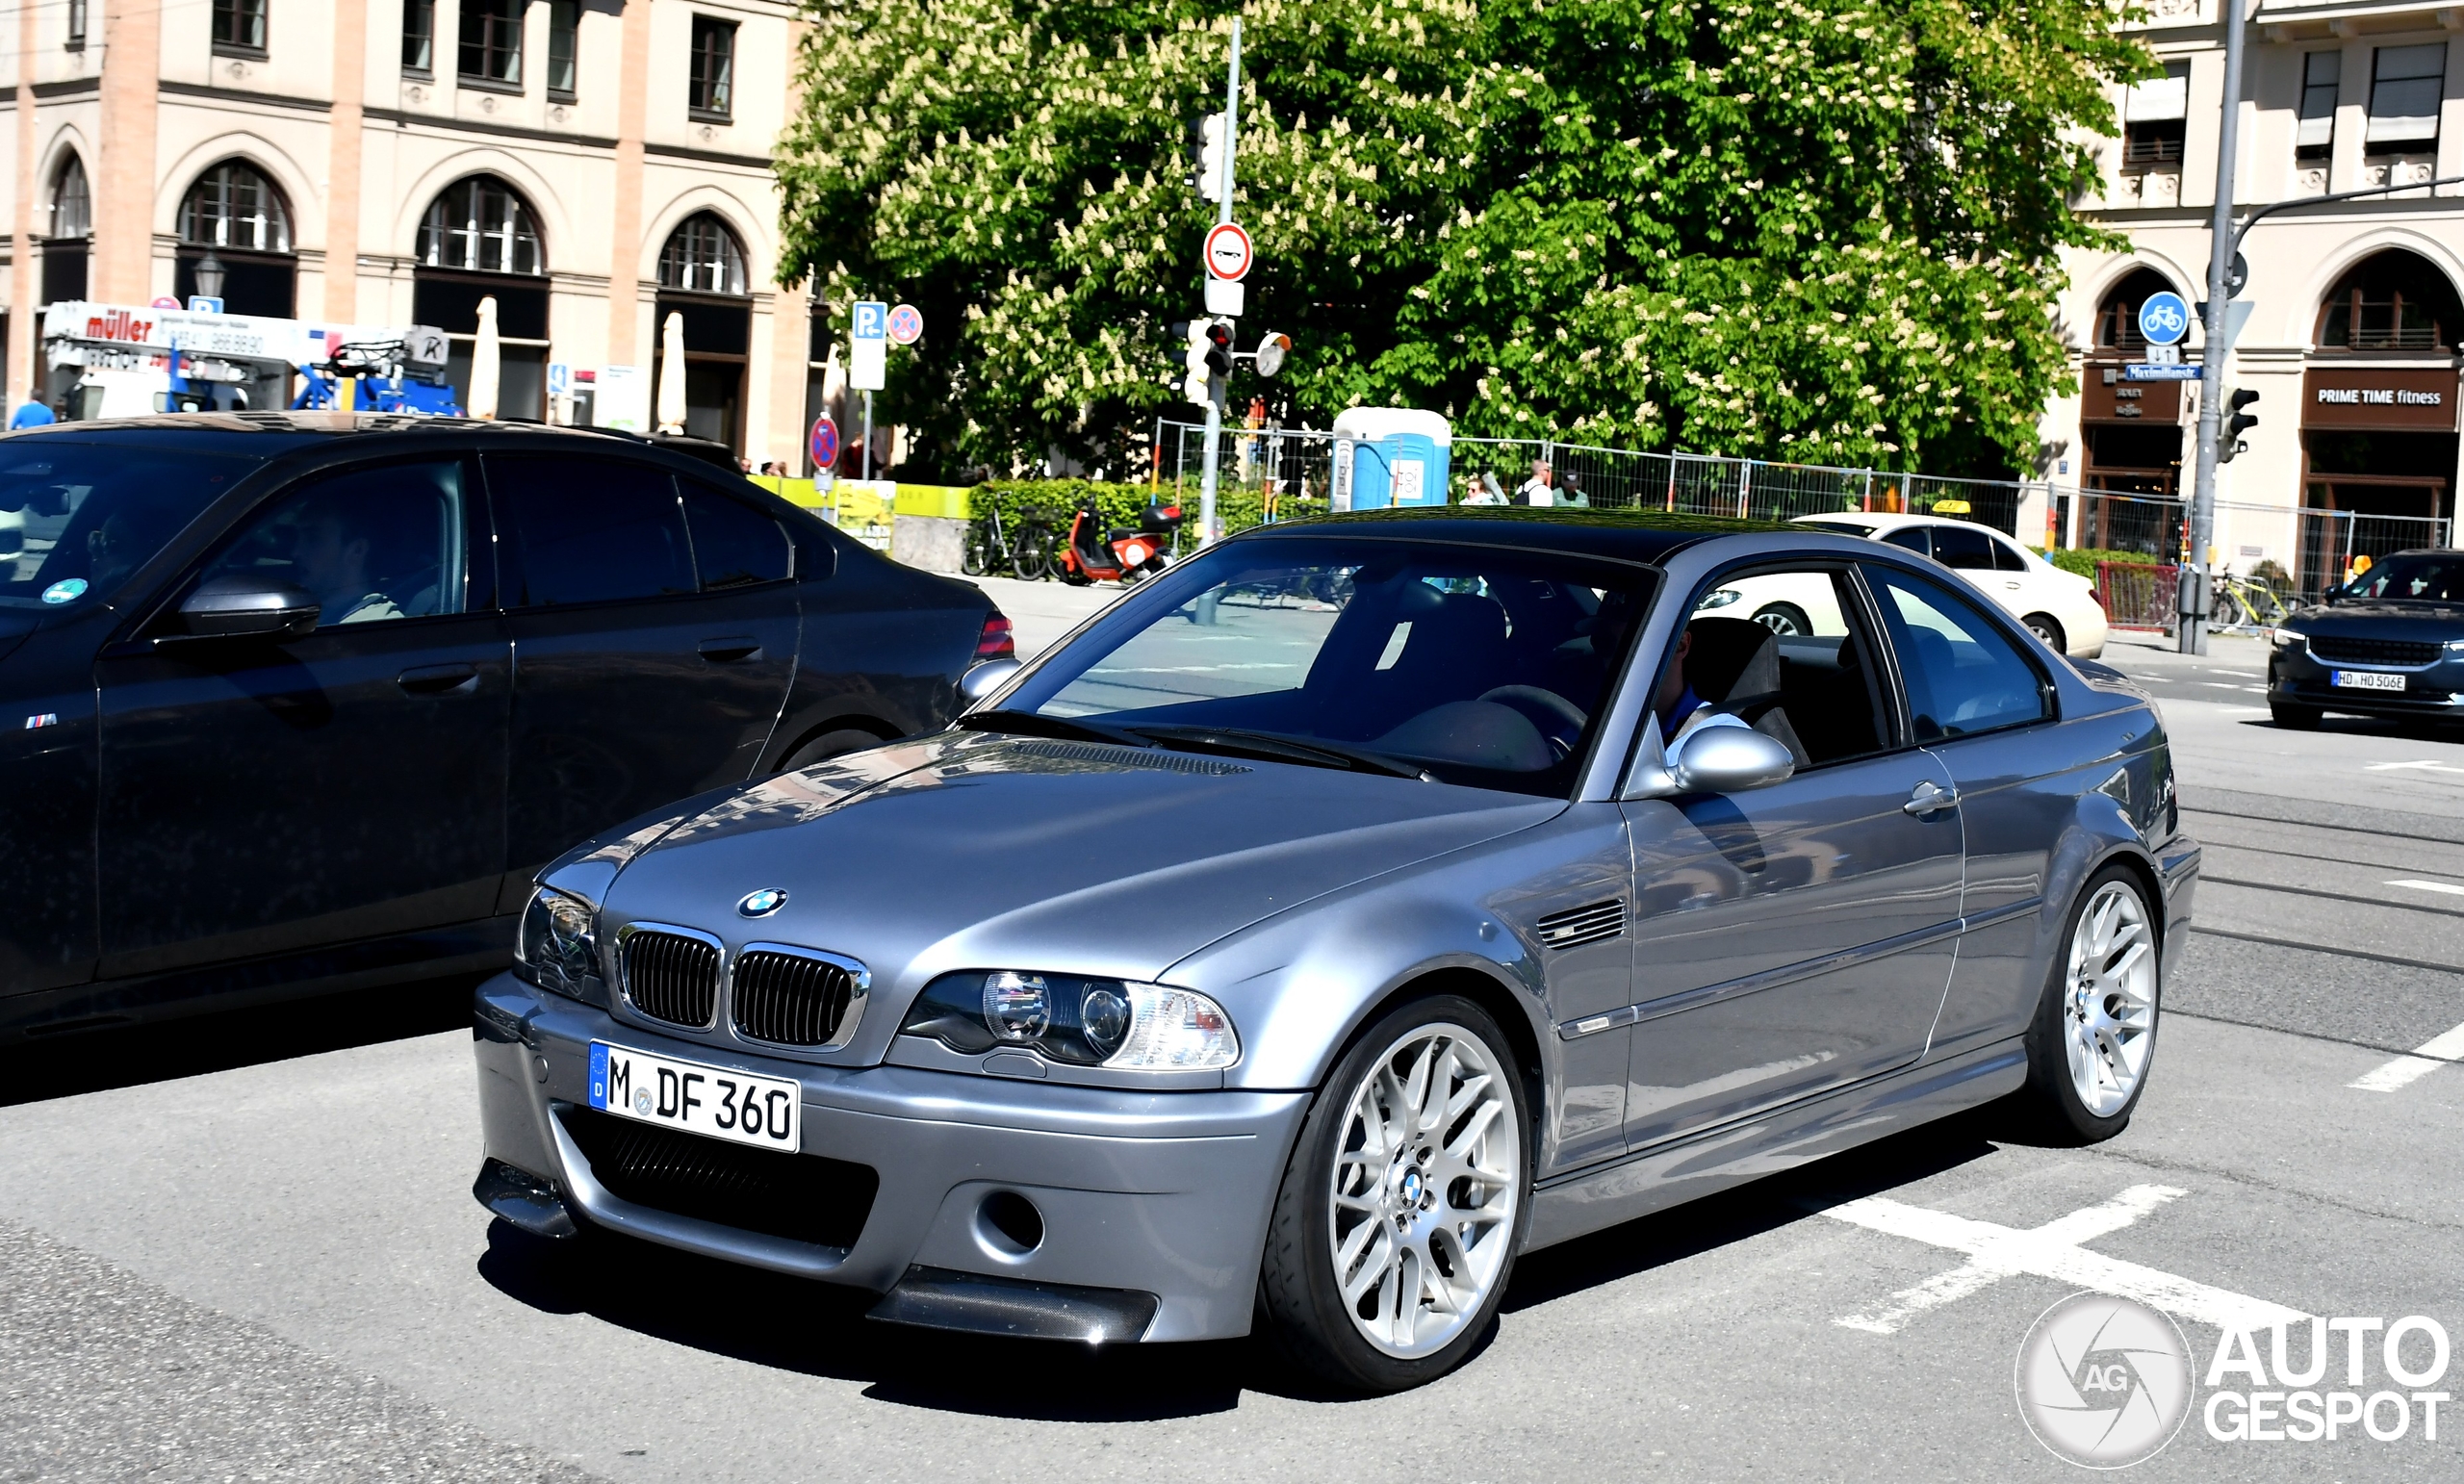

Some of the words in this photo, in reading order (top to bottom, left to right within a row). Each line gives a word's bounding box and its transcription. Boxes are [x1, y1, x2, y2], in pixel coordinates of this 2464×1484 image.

[87, 310, 152, 343] müller
[859, 307, 877, 336] P
[2130, 367, 2195, 378] Maximilianstr.
[2318, 389, 2359, 402] PRIME
[2361, 390, 2394, 403] TIME
[2397, 390, 2441, 404] fitness
[2339, 674, 2352, 685] HD
[2360, 675, 2374, 686] HO
[2376, 676, 2403, 689] 506E
[594, 1083, 603, 1097] D
[609, 1056, 630, 1108] M
[656, 1066, 705, 1121] DF
[715, 1079, 790, 1140] 360
